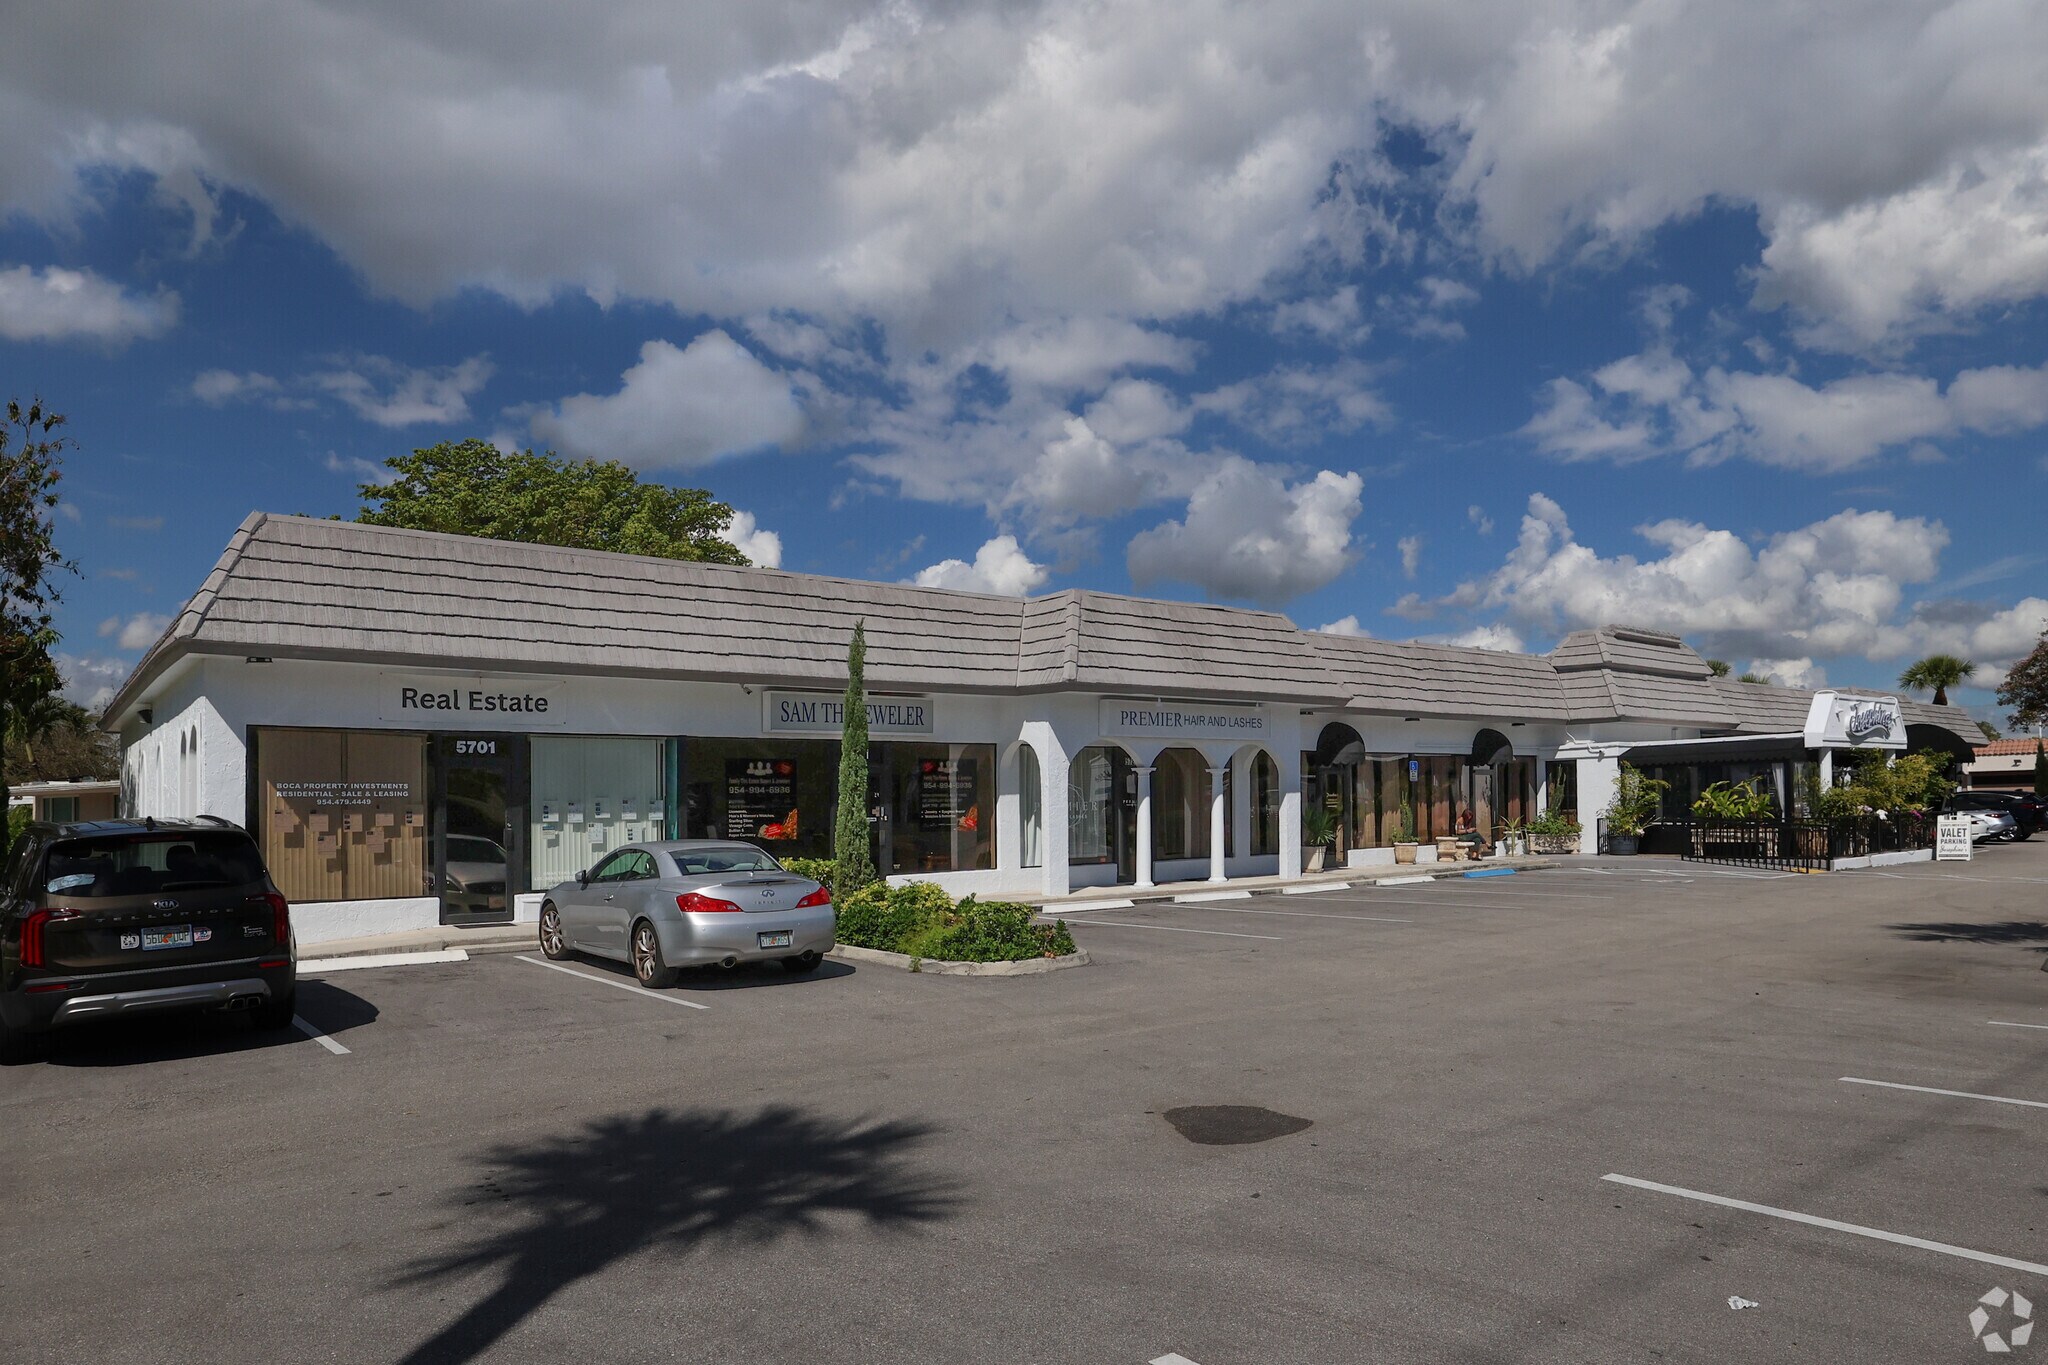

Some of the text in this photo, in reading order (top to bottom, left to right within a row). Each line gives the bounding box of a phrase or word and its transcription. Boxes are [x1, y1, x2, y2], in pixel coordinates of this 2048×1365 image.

[401, 687, 549, 713] Real Estate
[780, 700, 925, 726] SAM TH EWELER
[1120, 710, 1263, 729] PREMIER HAIR AND LASHES
[456, 740, 496, 754] 5701
[1940, 828, 1967, 838] VALET
[96, 907, 235, 923] TELLURIDE
